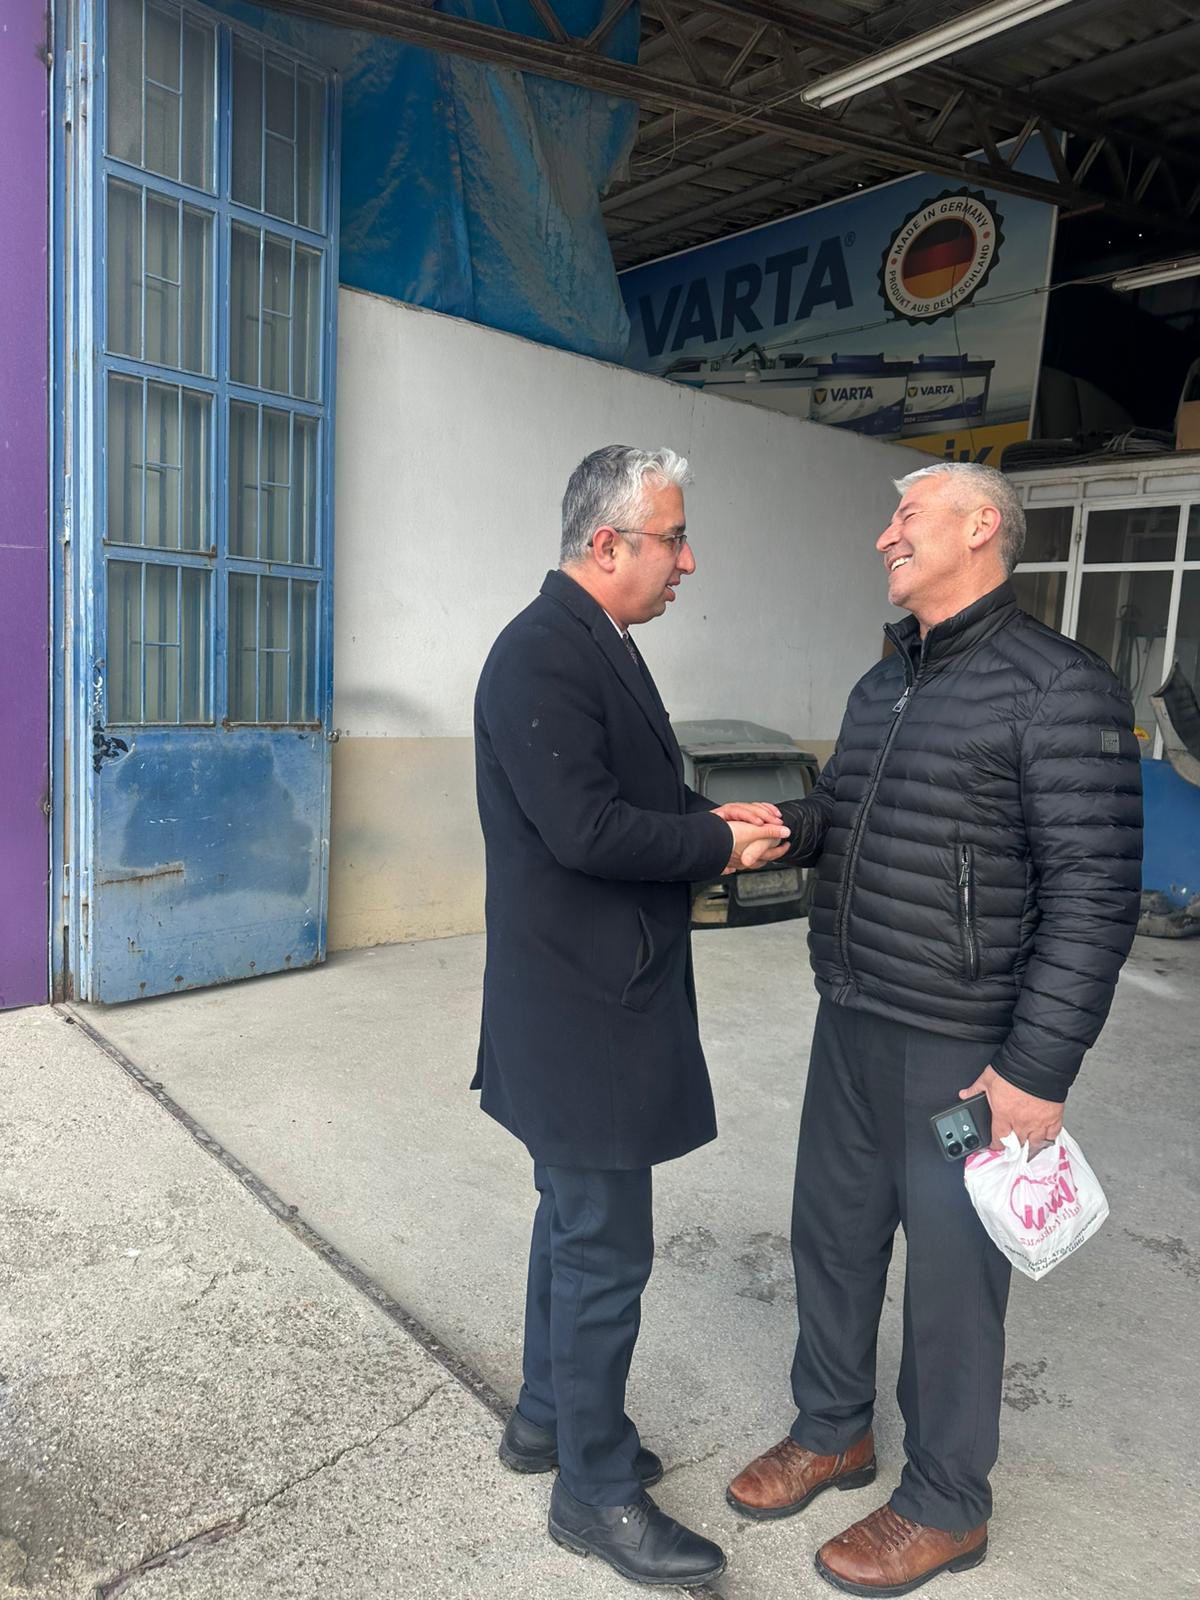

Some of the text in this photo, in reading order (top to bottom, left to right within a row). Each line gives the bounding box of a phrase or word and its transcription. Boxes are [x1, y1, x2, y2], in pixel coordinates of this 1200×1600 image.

[895, 201, 988, 255] MADE IN GERMANY
[889, 244, 990, 312] PRODUKT AUS DEUTSCHLAND
[830, 386, 873, 401] VARTA
[920, 385, 954, 396] VARTA
